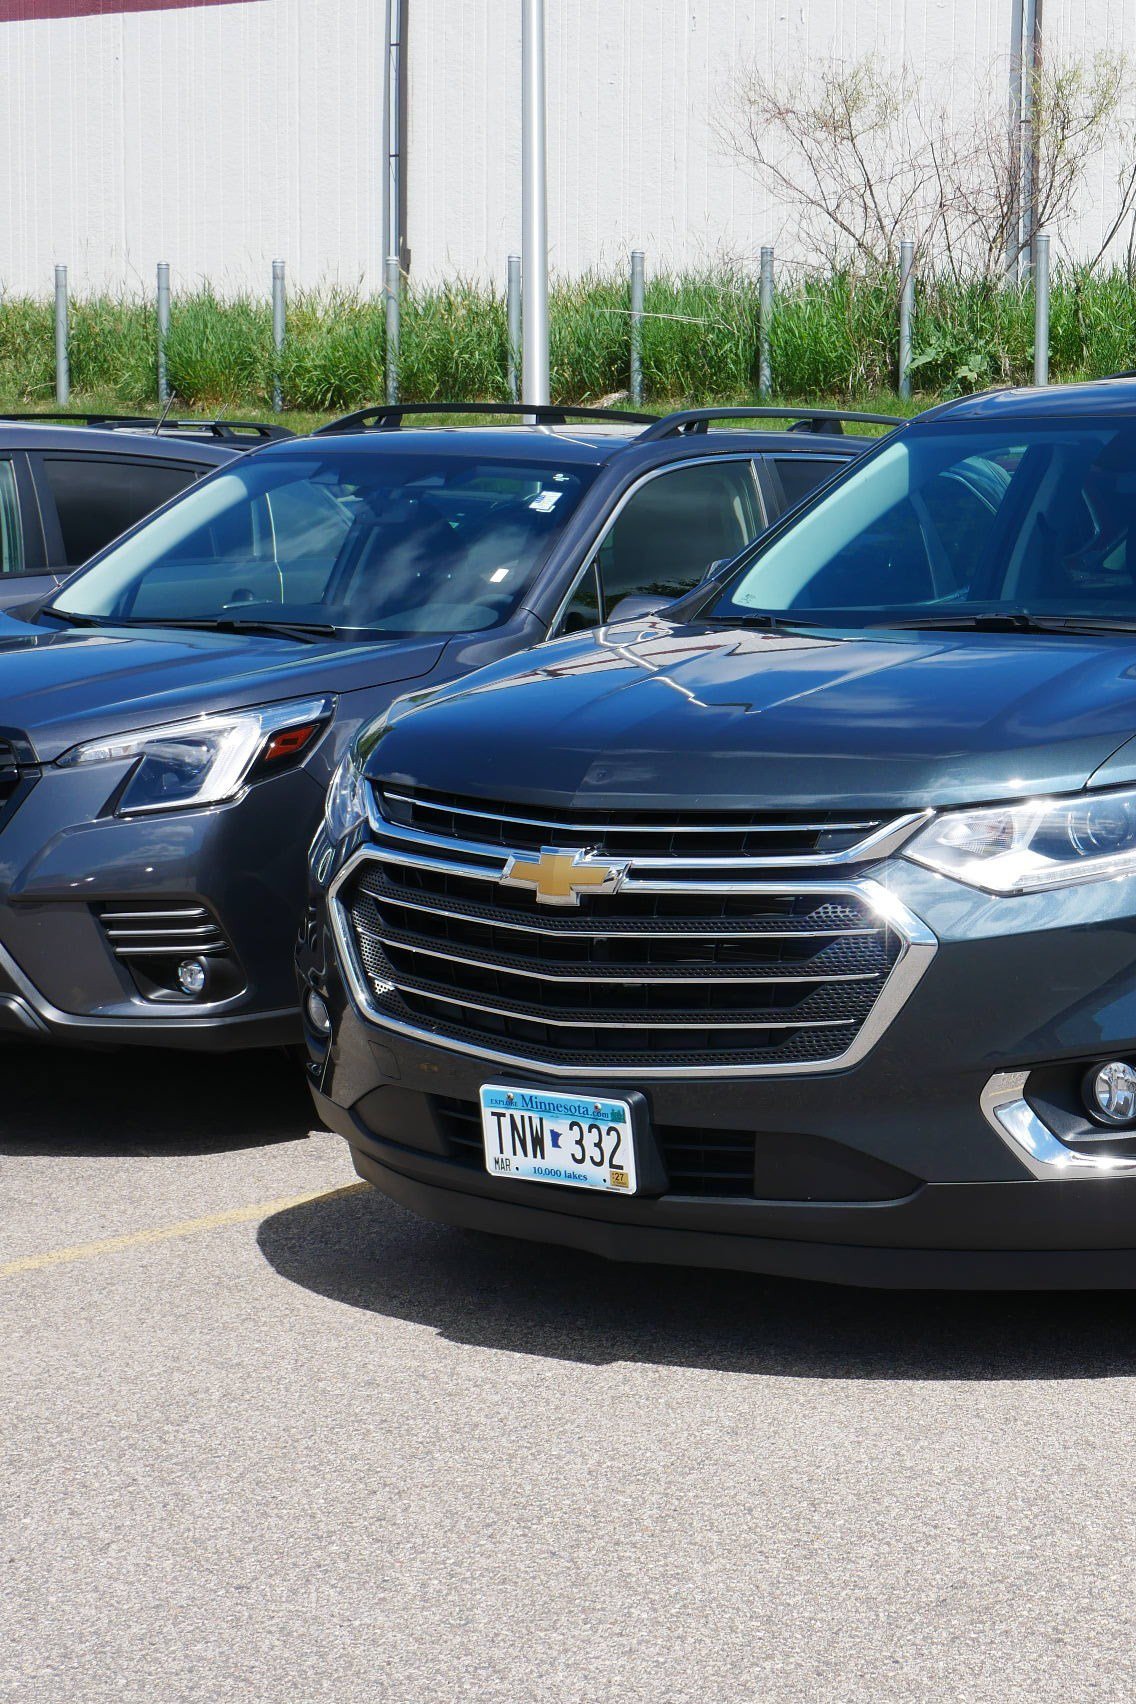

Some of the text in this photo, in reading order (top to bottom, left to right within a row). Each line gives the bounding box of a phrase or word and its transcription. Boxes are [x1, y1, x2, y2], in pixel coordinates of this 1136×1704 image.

[490, 1111, 624, 1171] TNW 332
[494, 1157, 511, 1172] MAR
[532, 1166, 588, 1182] 10,000 lakes
[614, 1172, 624, 1182] 27
